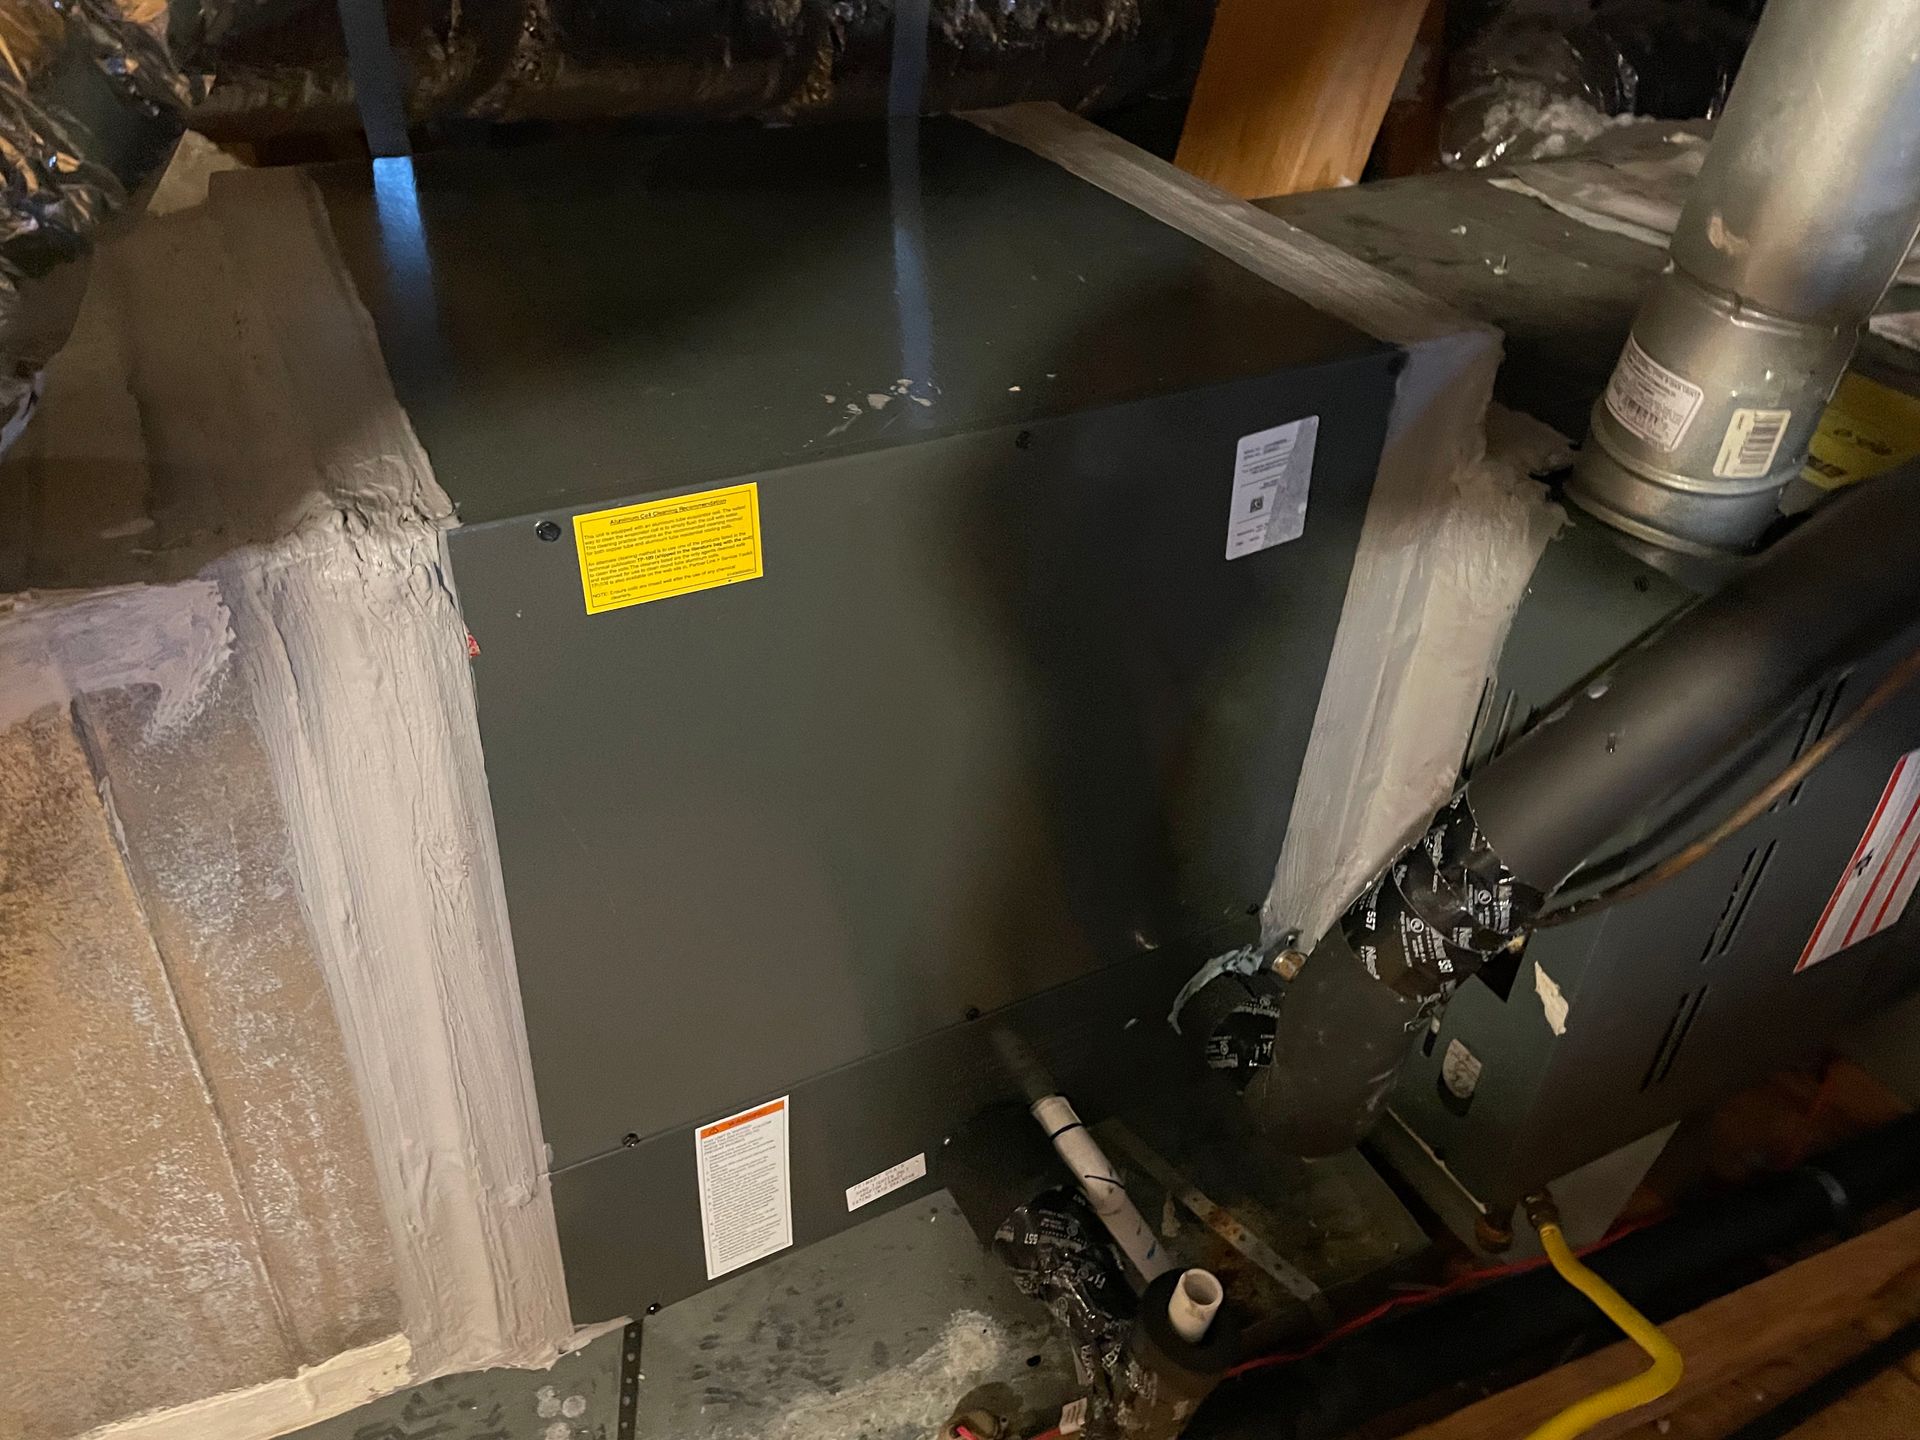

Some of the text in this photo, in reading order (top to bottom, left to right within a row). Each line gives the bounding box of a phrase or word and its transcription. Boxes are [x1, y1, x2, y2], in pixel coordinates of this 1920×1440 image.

[652, 508, 678, 517] Cleaning
[679, 498, 726, 512] Recommendation
[1365, 910, 1377, 931] 557
[1024, 1232, 1039, 1245] 557
